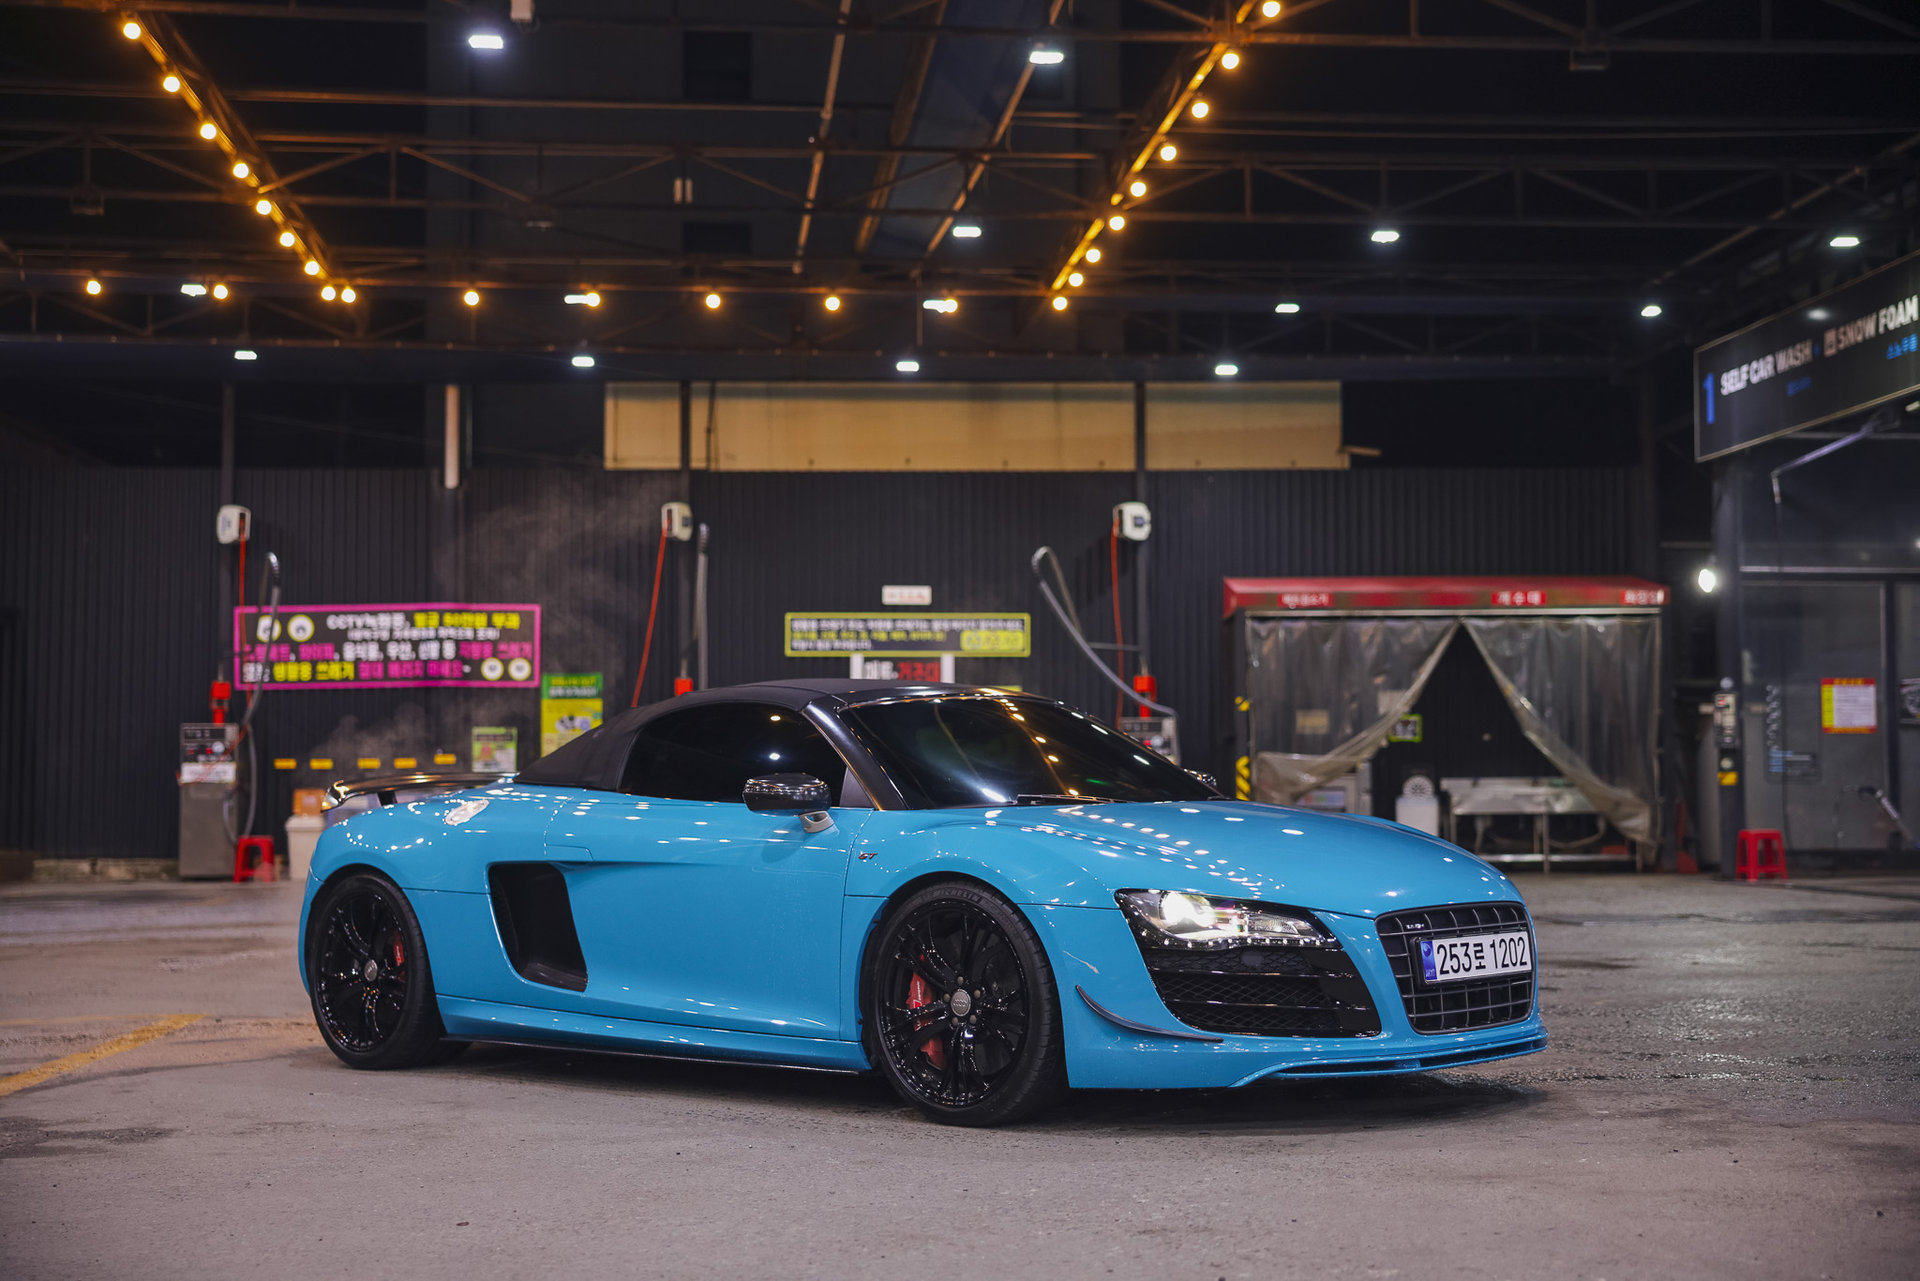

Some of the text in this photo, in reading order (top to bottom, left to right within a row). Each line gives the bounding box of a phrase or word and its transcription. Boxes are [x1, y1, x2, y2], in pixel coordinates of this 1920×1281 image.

[1720, 363, 1750, 396] SELF
[1749, 354, 1775, 385] CAR
[1775, 339, 1813, 374] WASH
[1837, 311, 1877, 350] SNOW
[1878, 293, 1919, 335] FOAM
[1703, 372, 1715, 425] 1
[858, 852, 878, 860] GT
[932, 888, 981, 902] MICHELIN
[1437, 936, 1528, 975] 253로 1202
